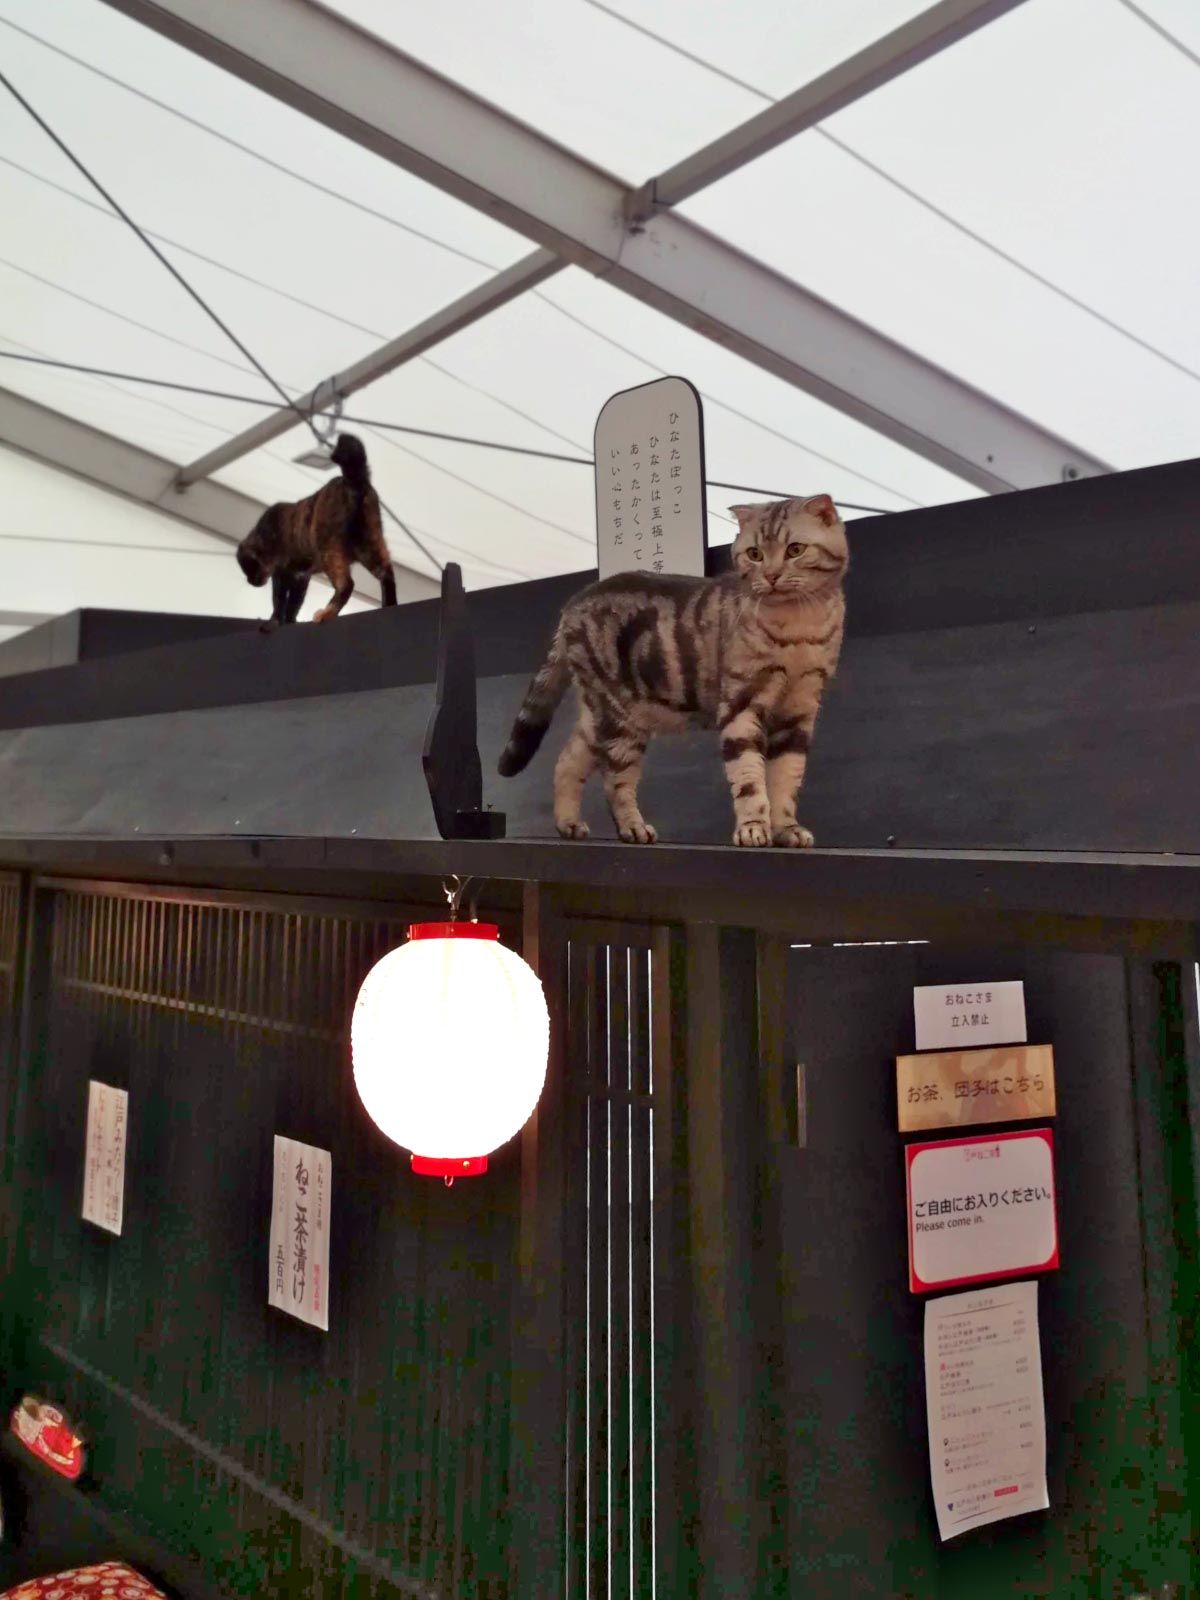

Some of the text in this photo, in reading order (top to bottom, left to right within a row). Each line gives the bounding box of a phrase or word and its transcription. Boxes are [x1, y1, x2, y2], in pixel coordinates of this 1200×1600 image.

[629, 443, 643, 561] あったかくって
[945, 992, 993, 1006] おねこさま
[951, 1013, 990, 1028] 立入禁止
[292, 1157, 309, 1304] ねこ茶漬け
[915, 1214, 985, 1233] Please come in.
